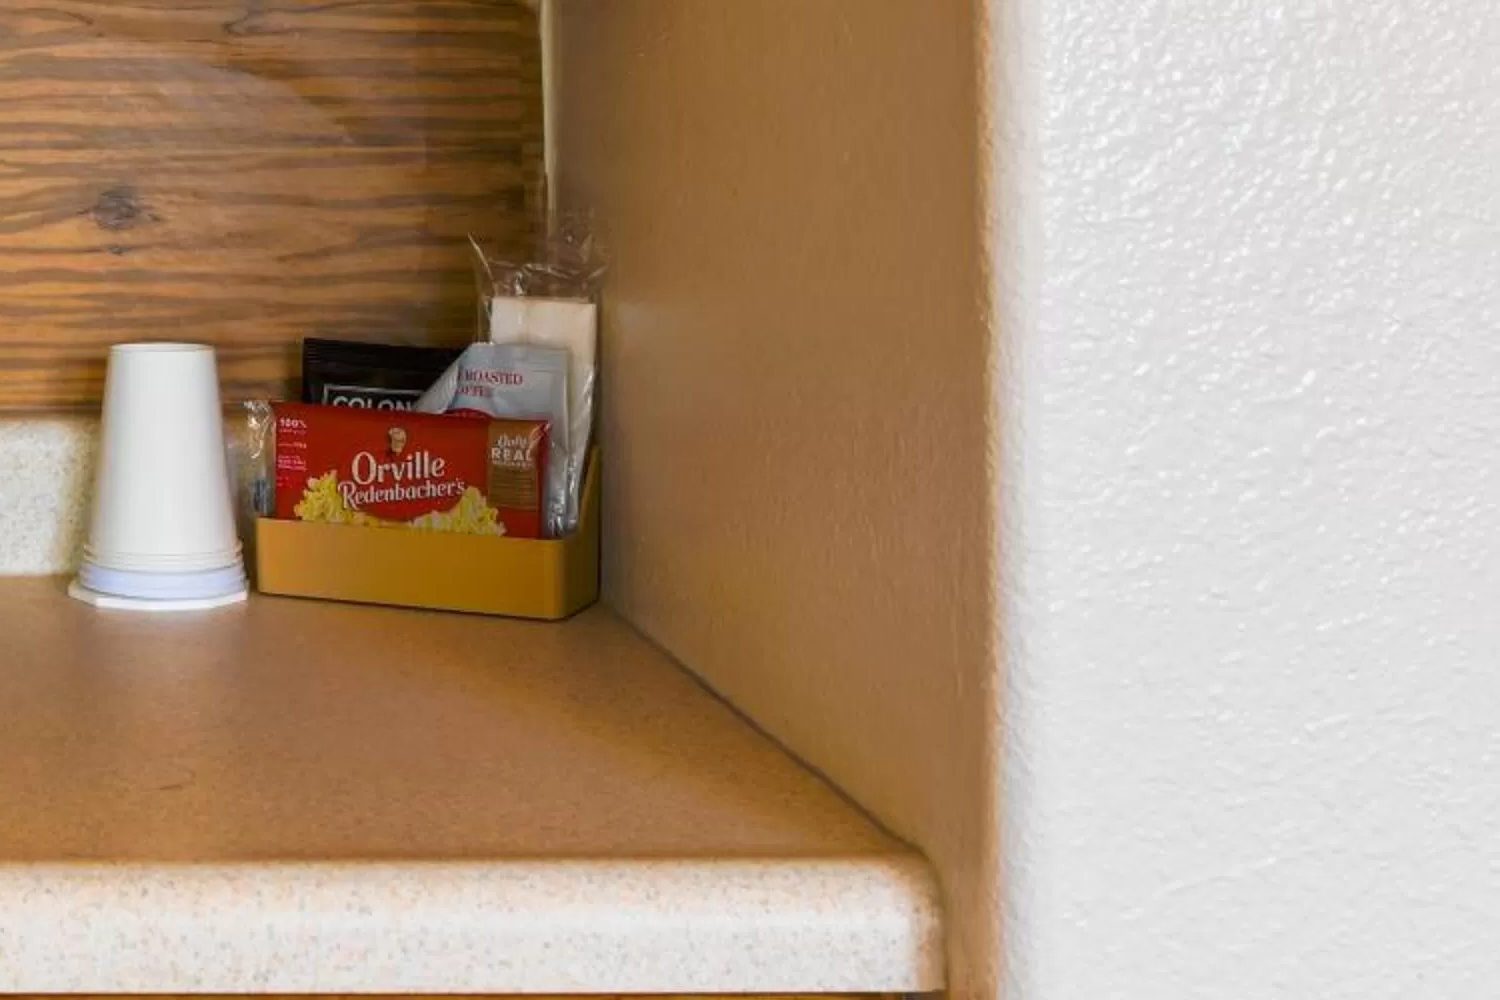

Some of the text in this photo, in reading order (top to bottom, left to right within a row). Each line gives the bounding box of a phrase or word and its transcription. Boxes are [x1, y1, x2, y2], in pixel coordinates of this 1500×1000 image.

[351, 450, 446, 485] Orville
[491, 448, 532, 461] REAL
[337, 477, 466, 511] Redenbacher's
